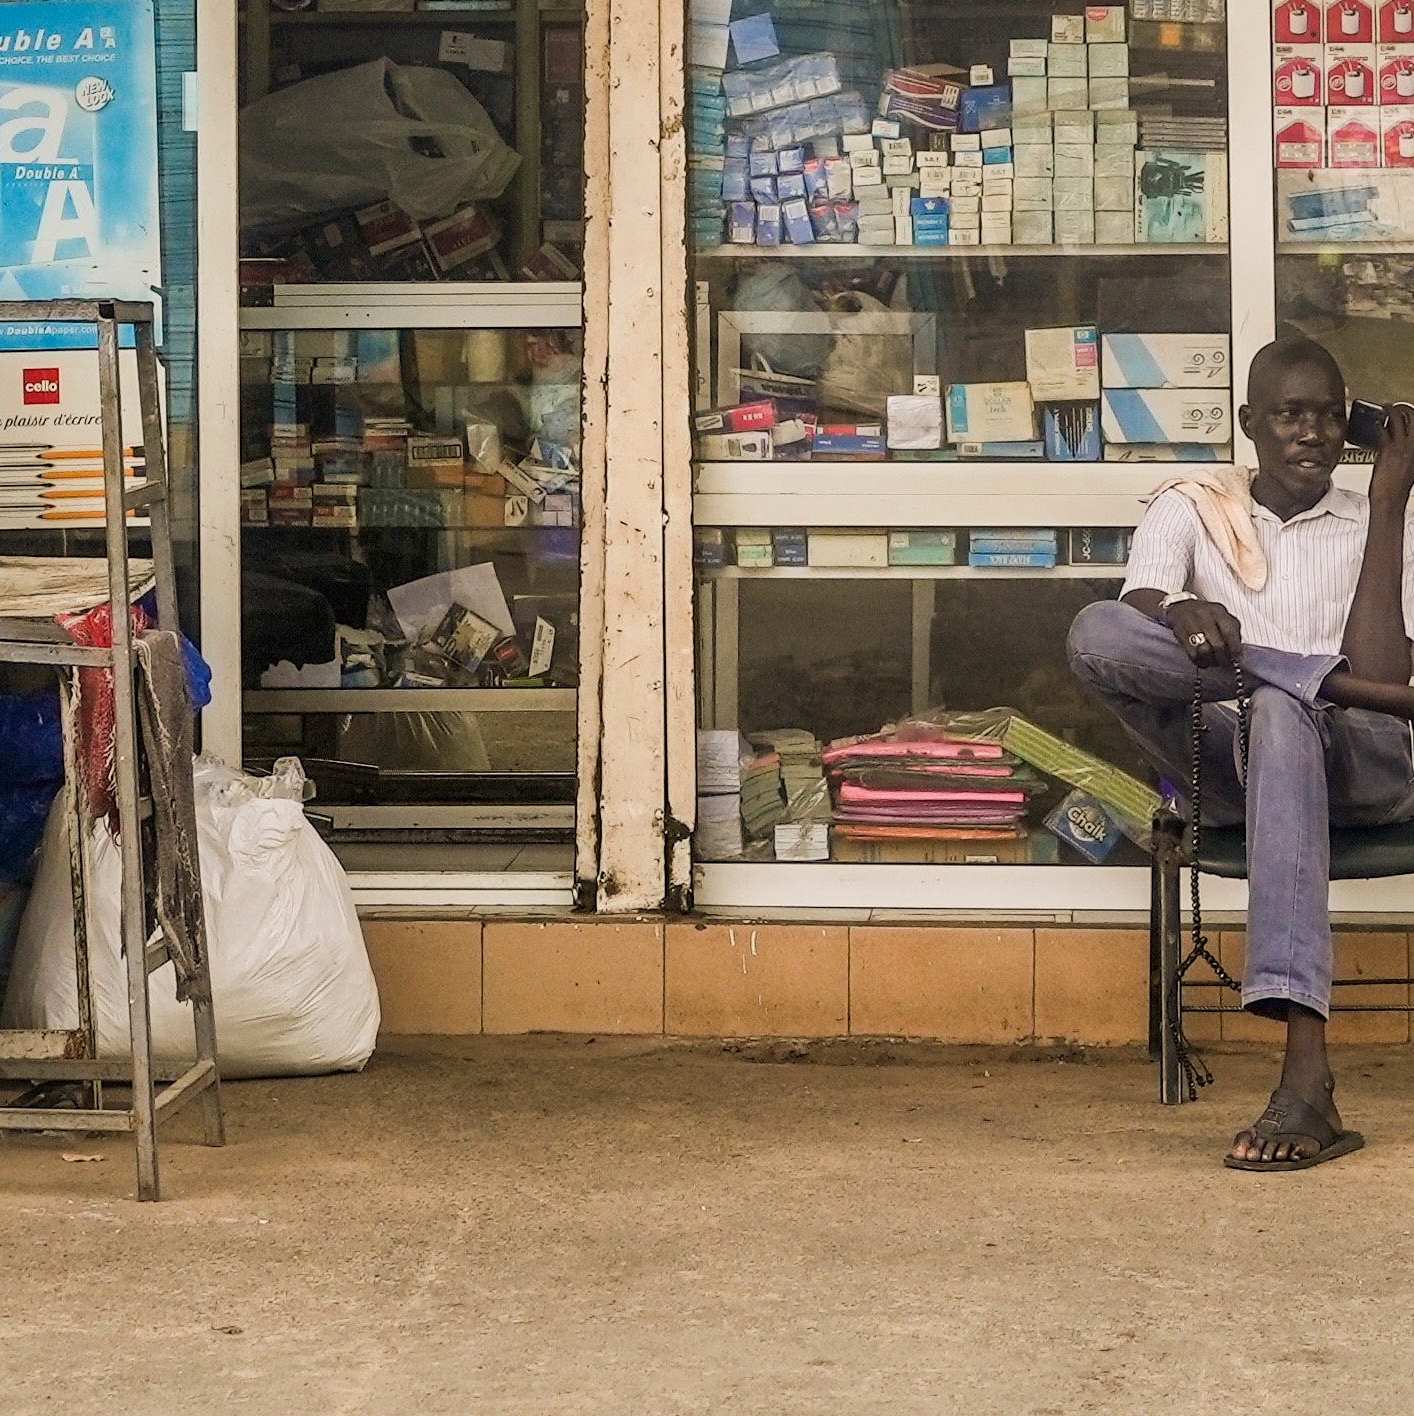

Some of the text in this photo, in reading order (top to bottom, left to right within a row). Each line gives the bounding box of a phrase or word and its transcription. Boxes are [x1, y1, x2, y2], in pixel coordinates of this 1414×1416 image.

[73, 27, 94, 50] A
[37, 55, 55, 64] THE
[56, 54, 80, 64] BEST
[82, 53, 117, 63] CHOICE
[83, 79, 111, 97] NEW
[86, 88, 116, 107] LOOK
[14, 165, 65, 181] Double
[25, 380, 58, 393] cello
[4, 414, 50, 431] plaisir
[1067, 806, 1107, 843] Chalk
